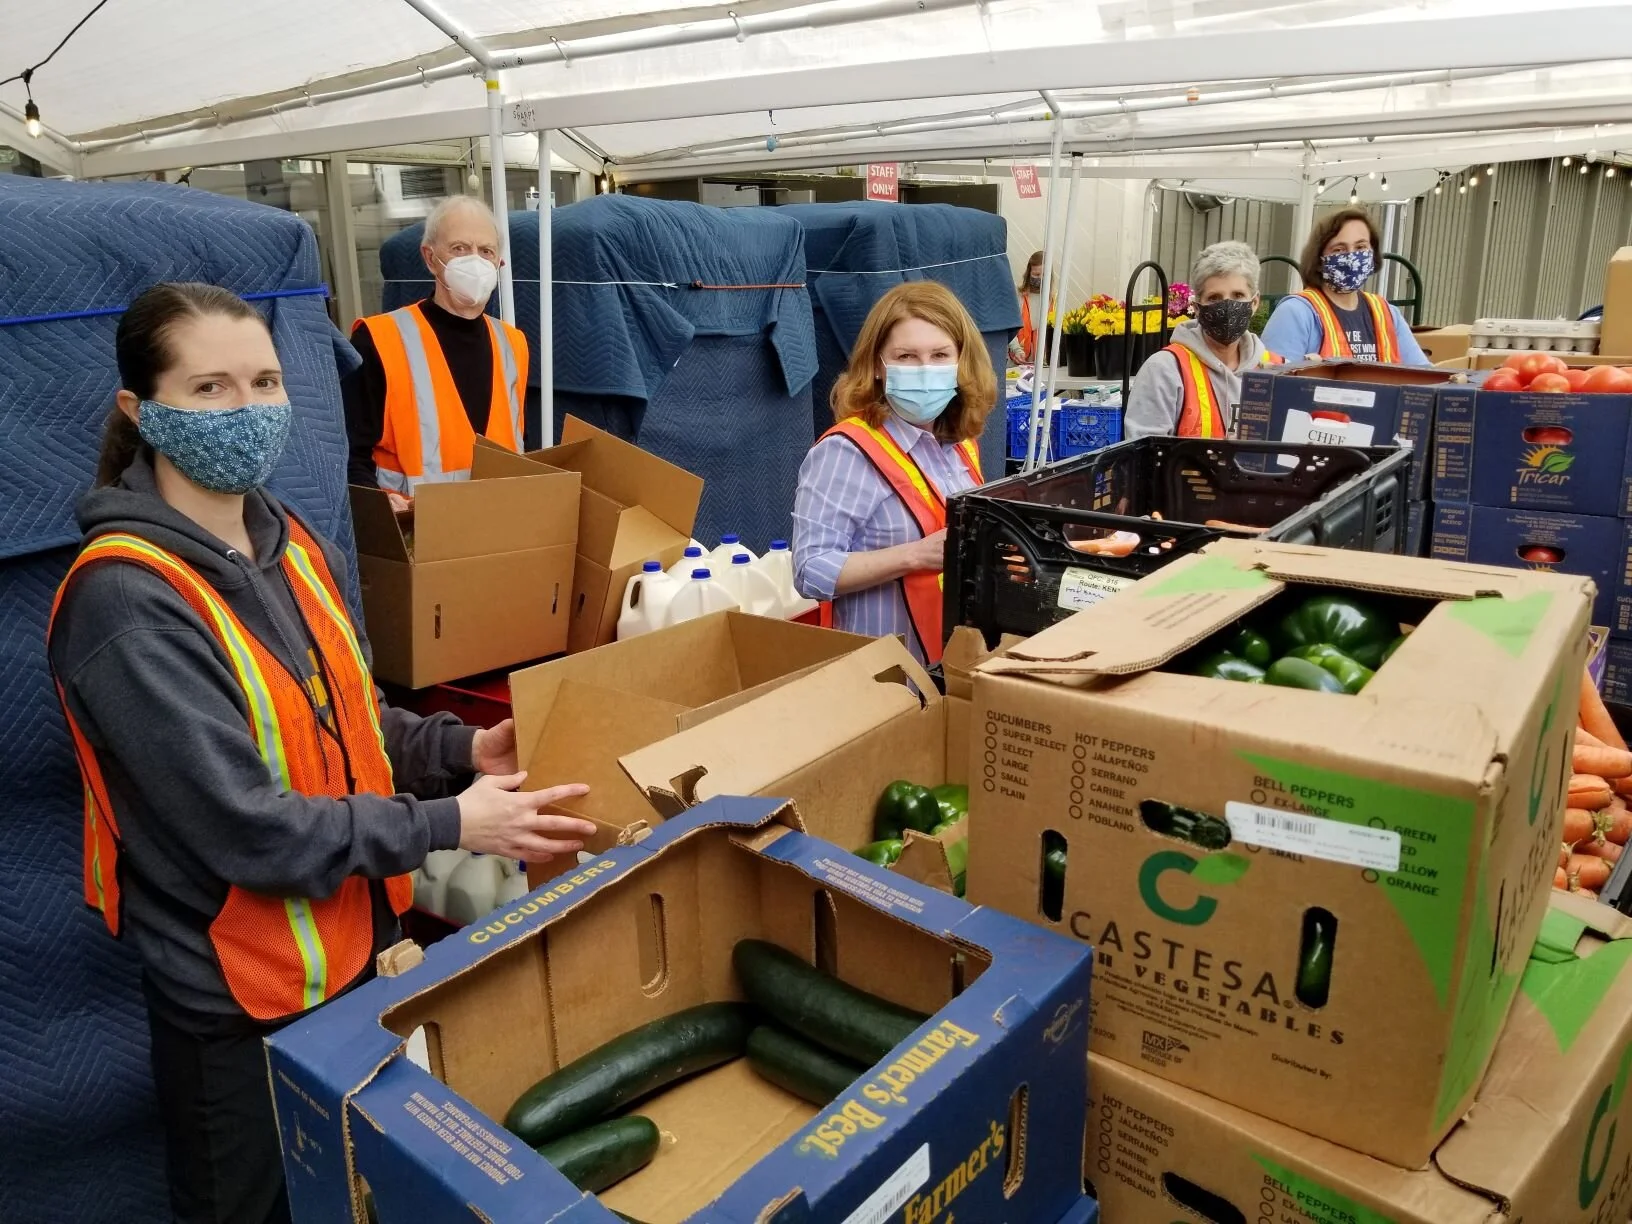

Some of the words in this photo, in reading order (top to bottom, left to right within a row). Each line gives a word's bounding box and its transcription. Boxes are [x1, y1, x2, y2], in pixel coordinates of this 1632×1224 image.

[870, 165, 894, 178] STAFF
[1016, 169, 1034, 182] STAFF
[872, 182, 895, 195] ONLY
[1020, 183, 1036, 194] ONLY
[1516, 468, 1570, 486] Tricar
[986, 709, 1052, 735] CUCUMBERS
[1002, 728, 1032, 743] SUPER
[1034, 736, 1067, 752] SELECT
[1074, 732, 1099, 746] HOT
[1101, 739, 1156, 761] PEPPERS
[1002, 743, 1034, 759] SELECT
[1001, 757, 1029, 772] LARGE
[1091, 751, 1149, 774] JALAPEÑOS
[1000, 772, 1029, 787] SMALL
[1091, 767, 1138, 787] SERRANO
[1000, 786, 1025, 801] PLAIN
[1090, 783, 1126, 800] CARIBE
[1253, 775, 1286, 793] BELL
[1290, 784, 1355, 809] PEPPERS
[1088, 798, 1133, 817] ANAHEIM
[1273, 797, 1331, 818] EX-LARGE
[1088, 813, 1134, 833] POBLANO
[1393, 826, 1437, 843] GREEN
[1267, 848, 1305, 864] SMALL
[1400, 844, 1417, 857] ED
[1400, 862, 1438, 879] ELLOW
[1386, 876, 1439, 897] ORANGE
[470, 860, 617, 943] CUCUMBERS
[1069, 910, 1280, 1006] CASTESA
[1134, 964, 1345, 1046] VEGETABLES
[862, 1019, 980, 1105] Farmer's
[1102, 1092, 1124, 1111] HOT
[1126, 1106, 1175, 1138] PEPPERS
[804, 1099, 887, 1158] Best
[1117, 1115, 1169, 1148] JALAPEÑOS
[1117, 1129, 1159, 1157] SERRANO
[1116, 1143, 1149, 1166] CARIBE
[903, 1120, 1004, 1224] Farmer's
[1115, 1157, 1156, 1185] ANAHEIM
[1114, 1170, 1157, 1199] POBLANO
[1263, 1174, 1293, 1198] BELL
[1296, 1191, 1358, 1224] PEPPERS
